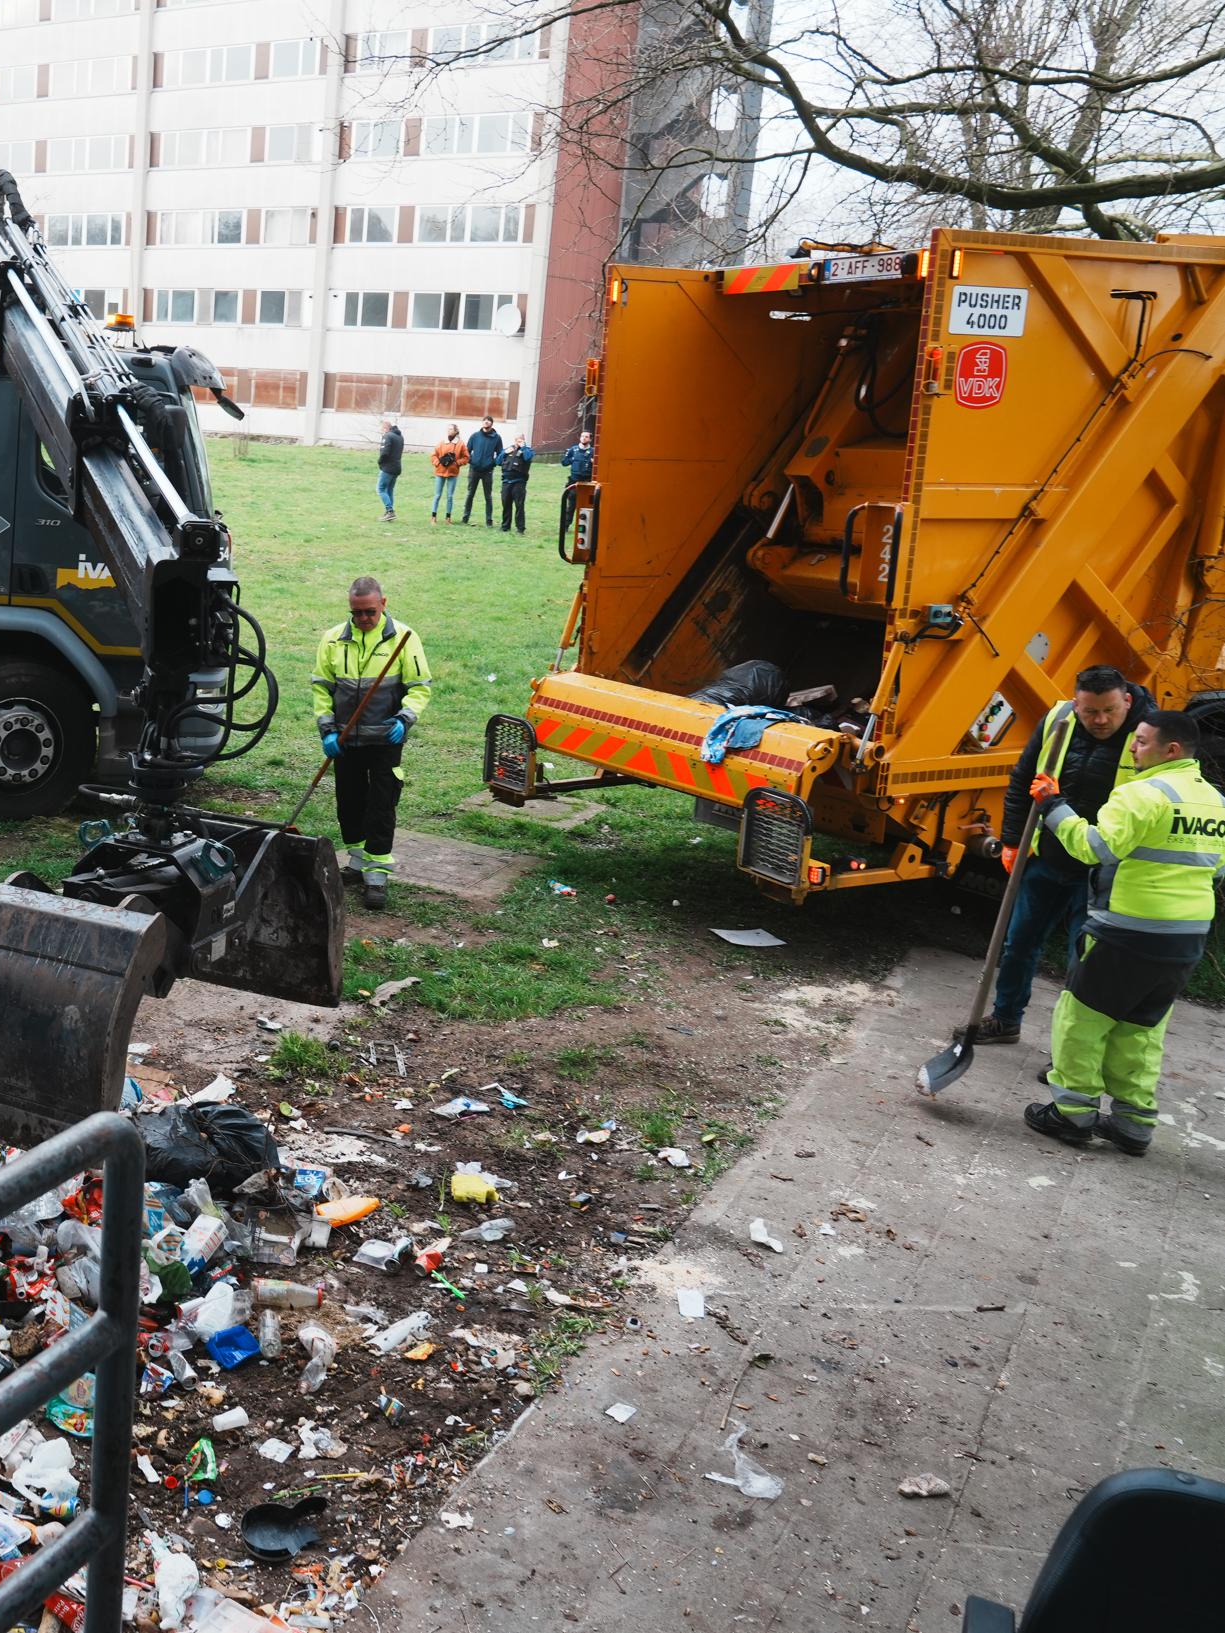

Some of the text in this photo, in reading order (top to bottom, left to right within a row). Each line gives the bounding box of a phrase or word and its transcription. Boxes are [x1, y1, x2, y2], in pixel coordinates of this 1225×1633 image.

[957, 292, 1022, 311] PUSHER
[966, 313, 1008, 330] 4000
[959, 378, 1001, 397] VDK
